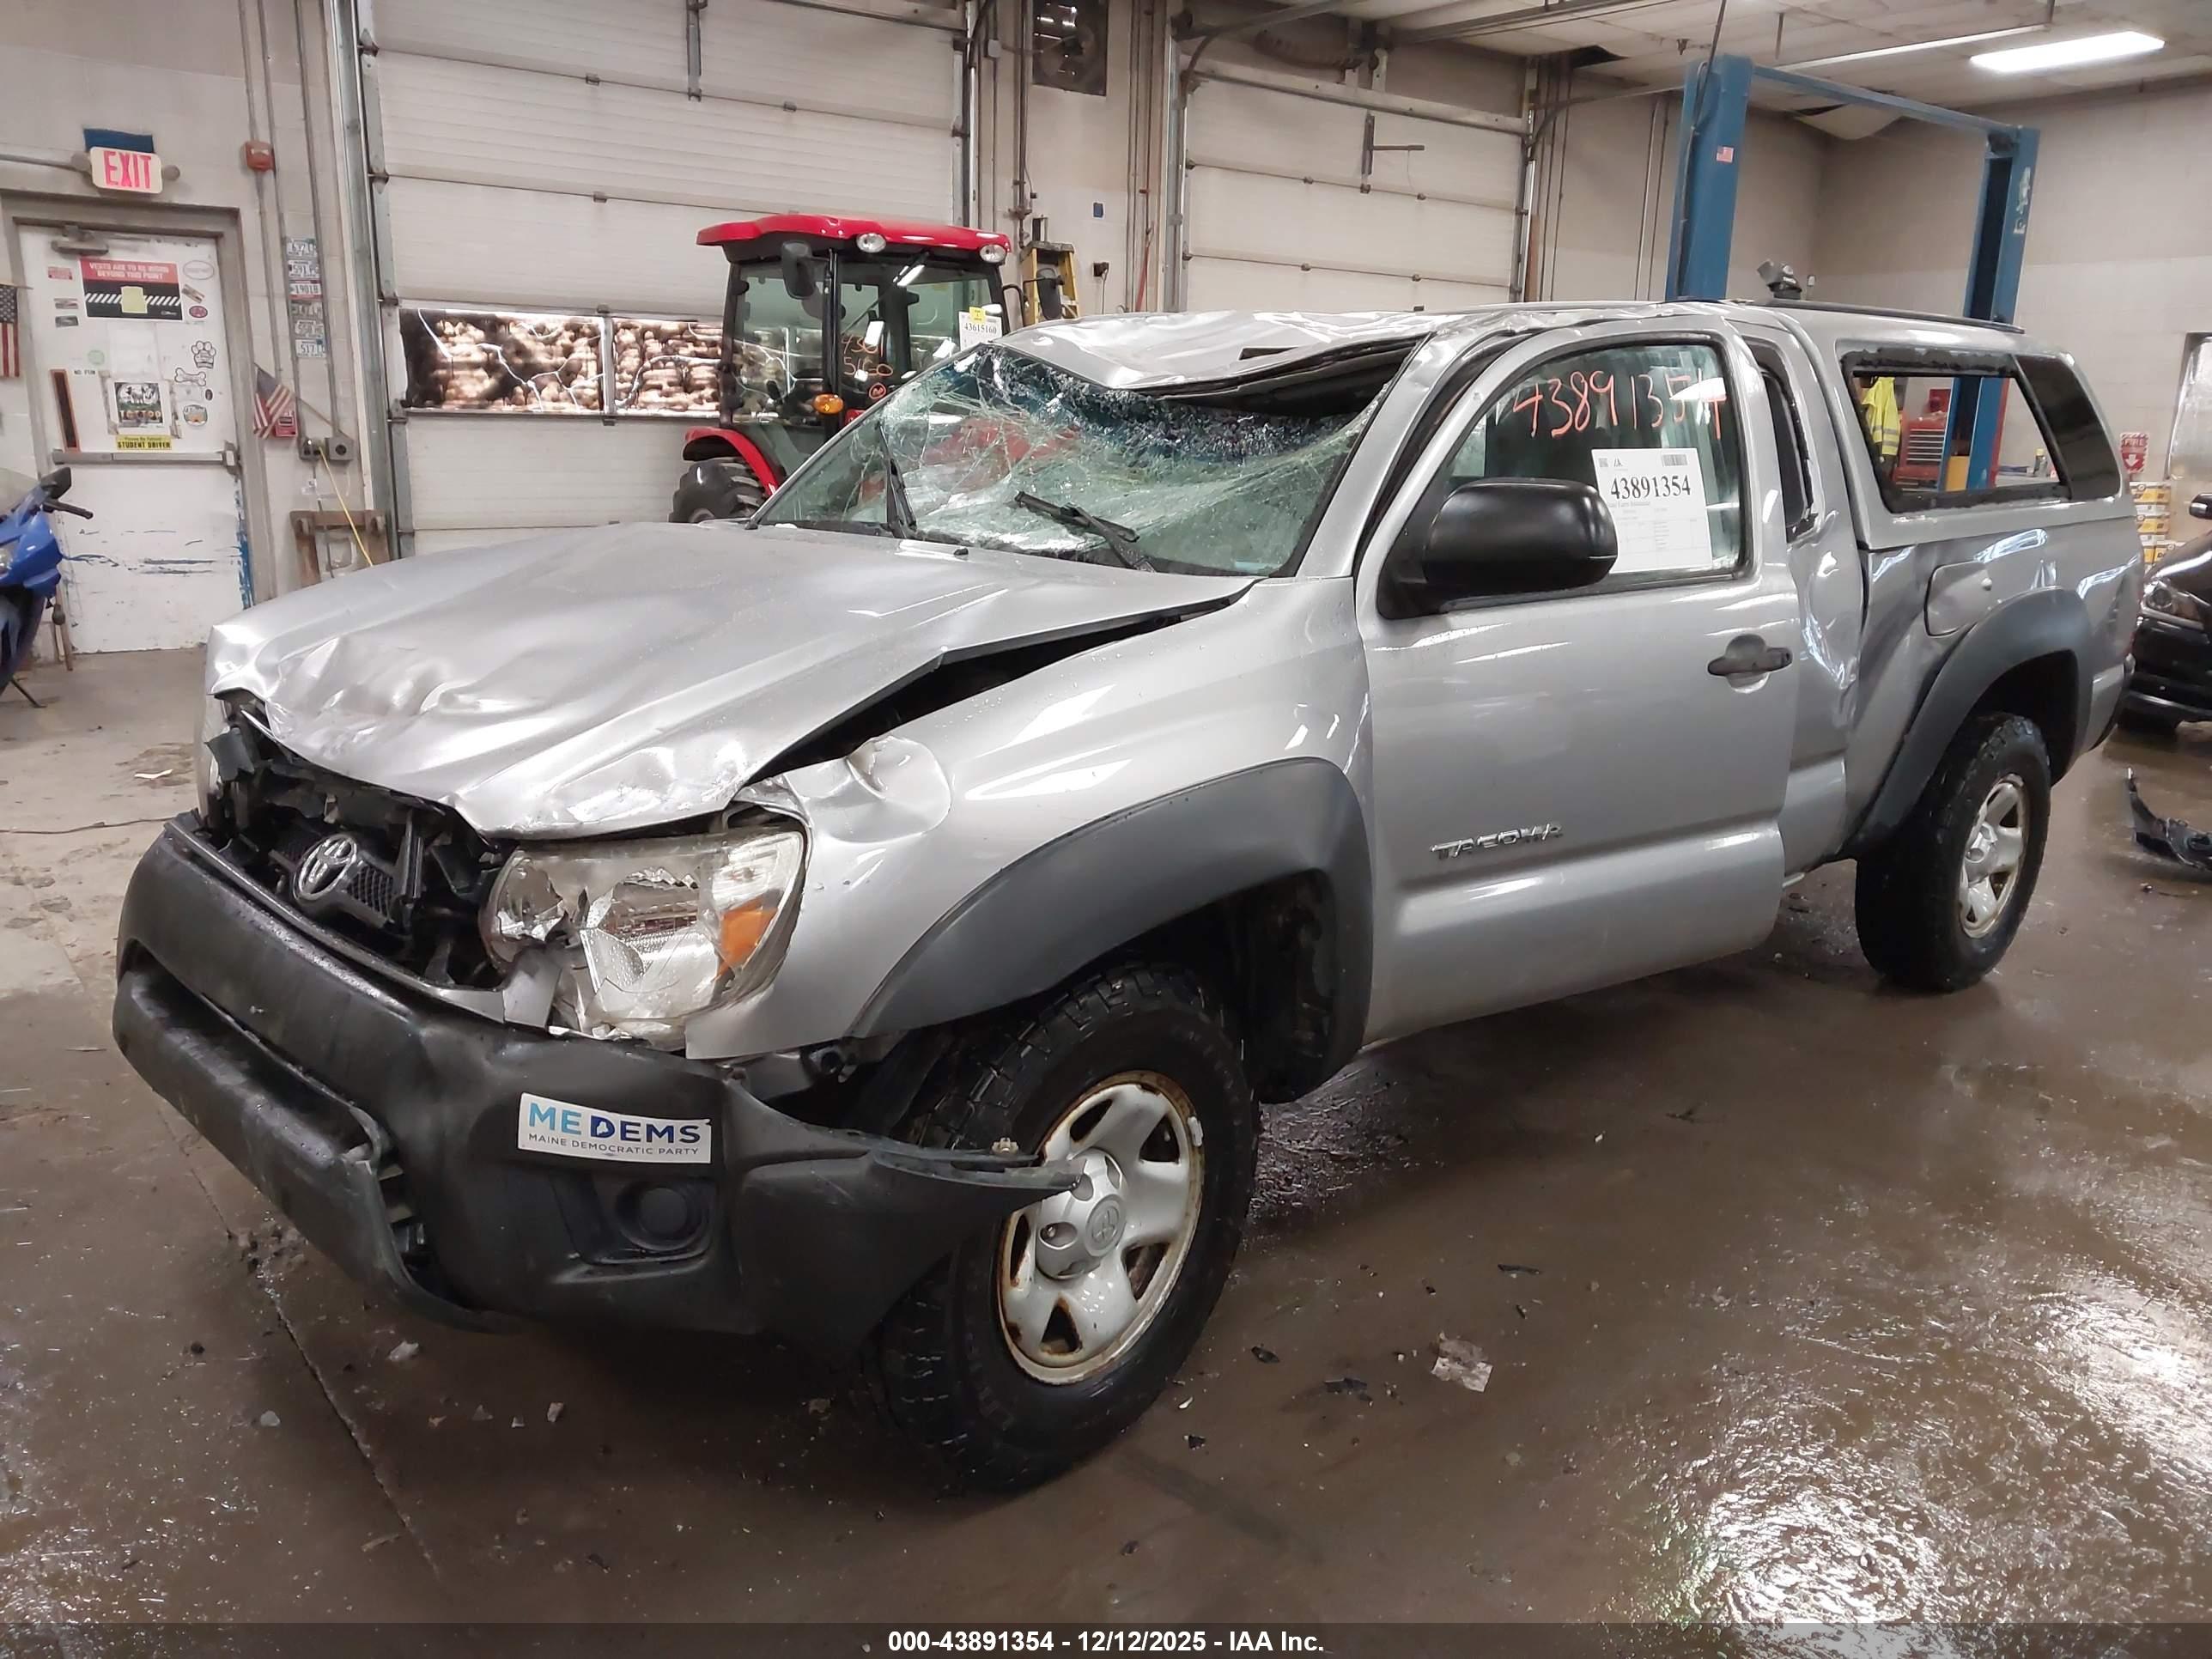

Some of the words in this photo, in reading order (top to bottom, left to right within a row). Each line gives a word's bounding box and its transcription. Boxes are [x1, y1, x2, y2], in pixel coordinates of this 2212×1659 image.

[103, 150, 152, 189] EXIT
[964, 322, 997, 334] 43615160
[1610, 474, 1691, 499] 43891354
[1431, 822, 1563, 859] TACOMA
[529, 1103, 581, 1135] ME
[590, 1115, 701, 1145] DEMS
[529, 1133, 567, 1146] MAINE
[571, 1139, 653, 1155] DEMOCRATIC
